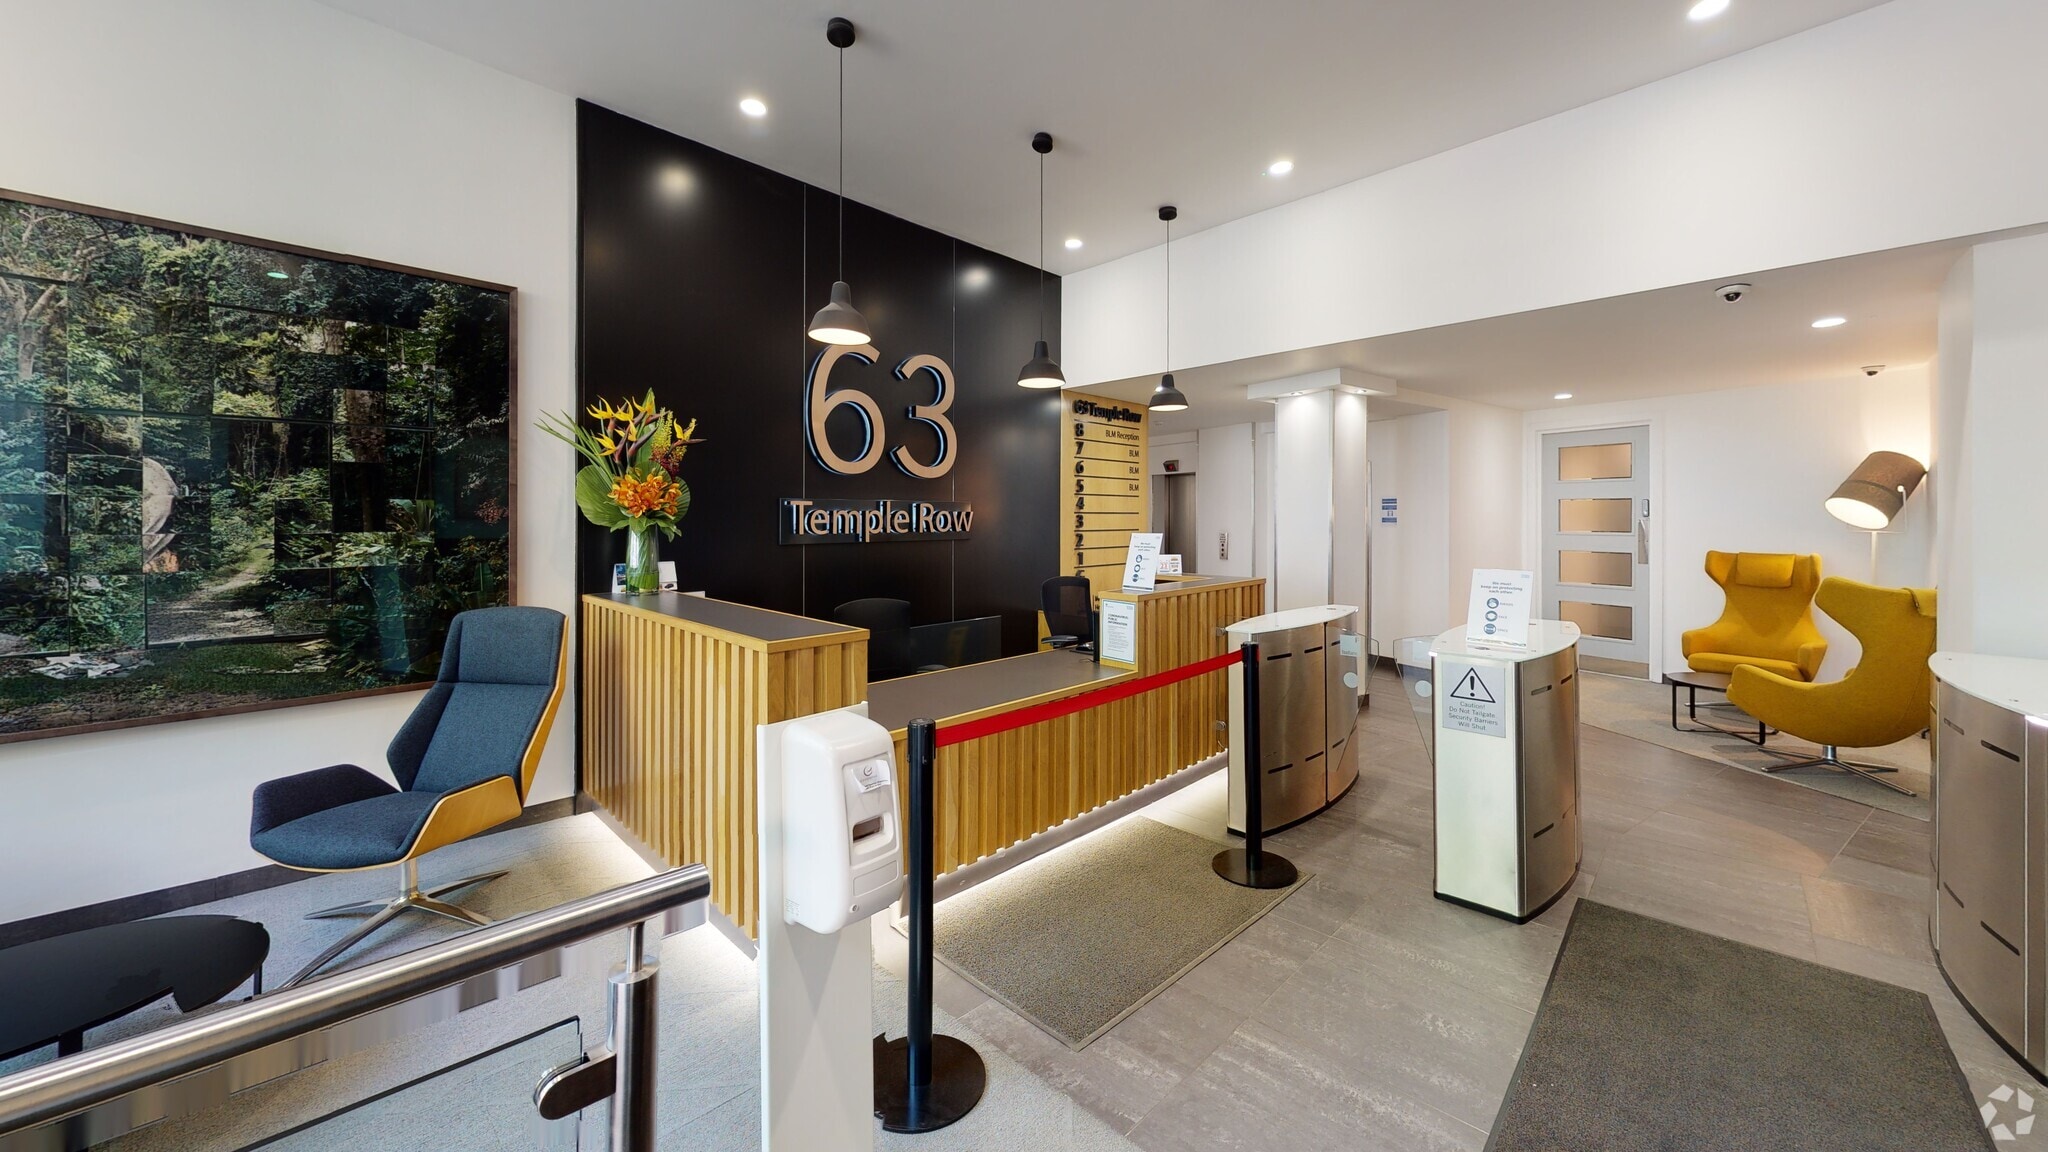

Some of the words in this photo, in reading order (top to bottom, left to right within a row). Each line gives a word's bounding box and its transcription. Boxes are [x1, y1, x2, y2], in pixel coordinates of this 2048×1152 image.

[805, 343, 957, 479] 63
[1074, 399, 1089, 415] 63
[1088, 402, 1121, 422] Temple
[1122, 408, 1142, 423] Row
[1075, 423, 1084, 437] 8
[1105, 430, 1116, 438] BLM
[1117, 432, 1140, 441] Reception
[1075, 441, 1084, 455] 7
[1129, 449, 1139, 457] BLM
[1075, 460, 1084, 474] 6
[1129, 466, 1139, 474] BLM
[1075, 479, 1084, 493] 5
[1129, 483, 1139, 491] BLM
[1075, 497, 1085, 510] 4
[785, 500, 910, 542] Temple
[912, 502, 974, 534] Row
[1075, 515, 1084, 529] 3
[1075, 533, 1084, 547] 2
[1076, 552, 1084, 565] 1
[1448, 712, 1473, 722] Security
[1474, 716, 1499, 726] Barriers
[1459, 707, 1470, 715] Not
[1472, 709, 1496, 719] Tailgate
[1471, 722, 1486, 731] Shut
